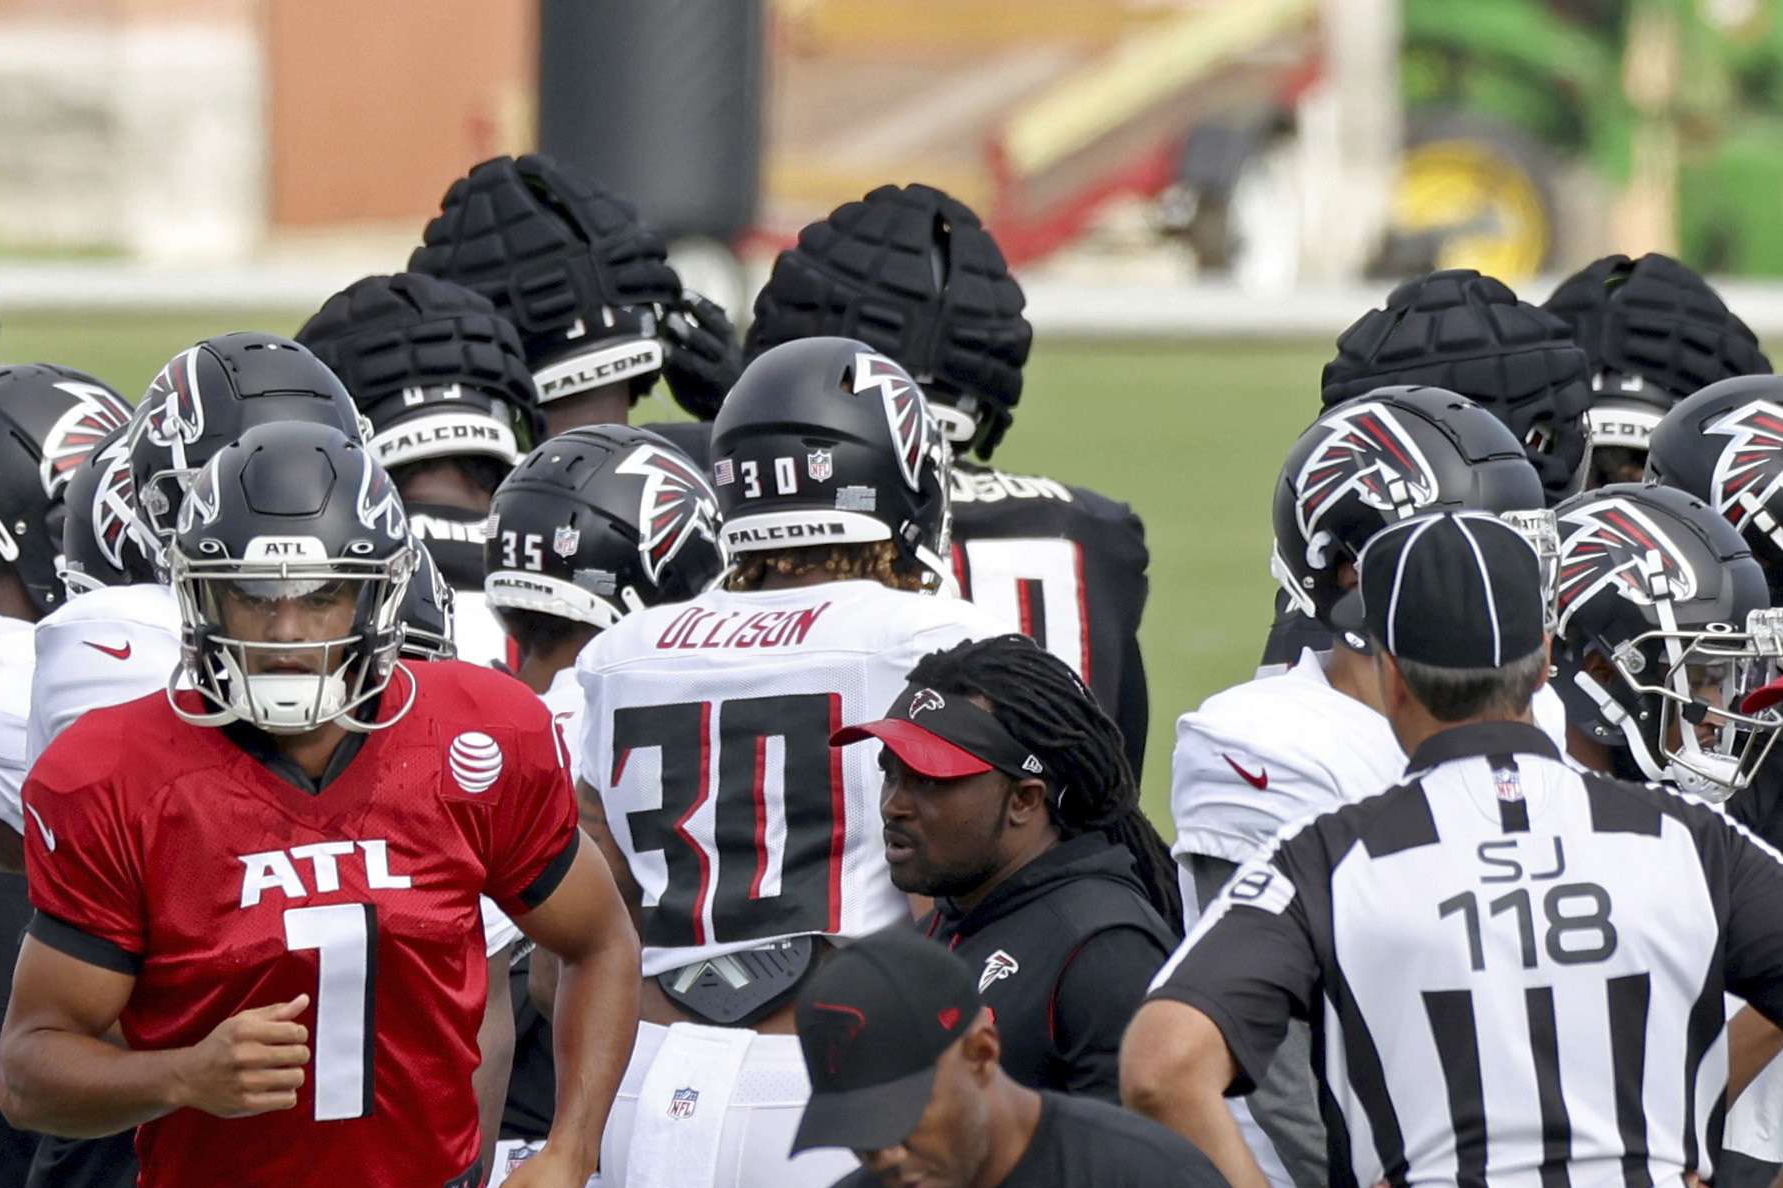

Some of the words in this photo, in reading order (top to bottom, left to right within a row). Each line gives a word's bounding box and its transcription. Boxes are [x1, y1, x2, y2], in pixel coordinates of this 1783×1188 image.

[541, 352, 656, 395] FALCONS
[378, 423, 500, 457] FALCONS
[740, 456, 799, 499] 30
[264, 542, 307, 556] ATL
[500, 530, 544, 571] 35
[727, 522, 846, 546] FALCONS
[655, 601, 833, 649] OLLISON
[611, 692, 842, 948] 30
[236, 838, 413, 910] ATL
[1477, 835, 1566, 884] SJ
[1438, 882, 1618, 971] 118
[282, 901, 376, 1122] 1
